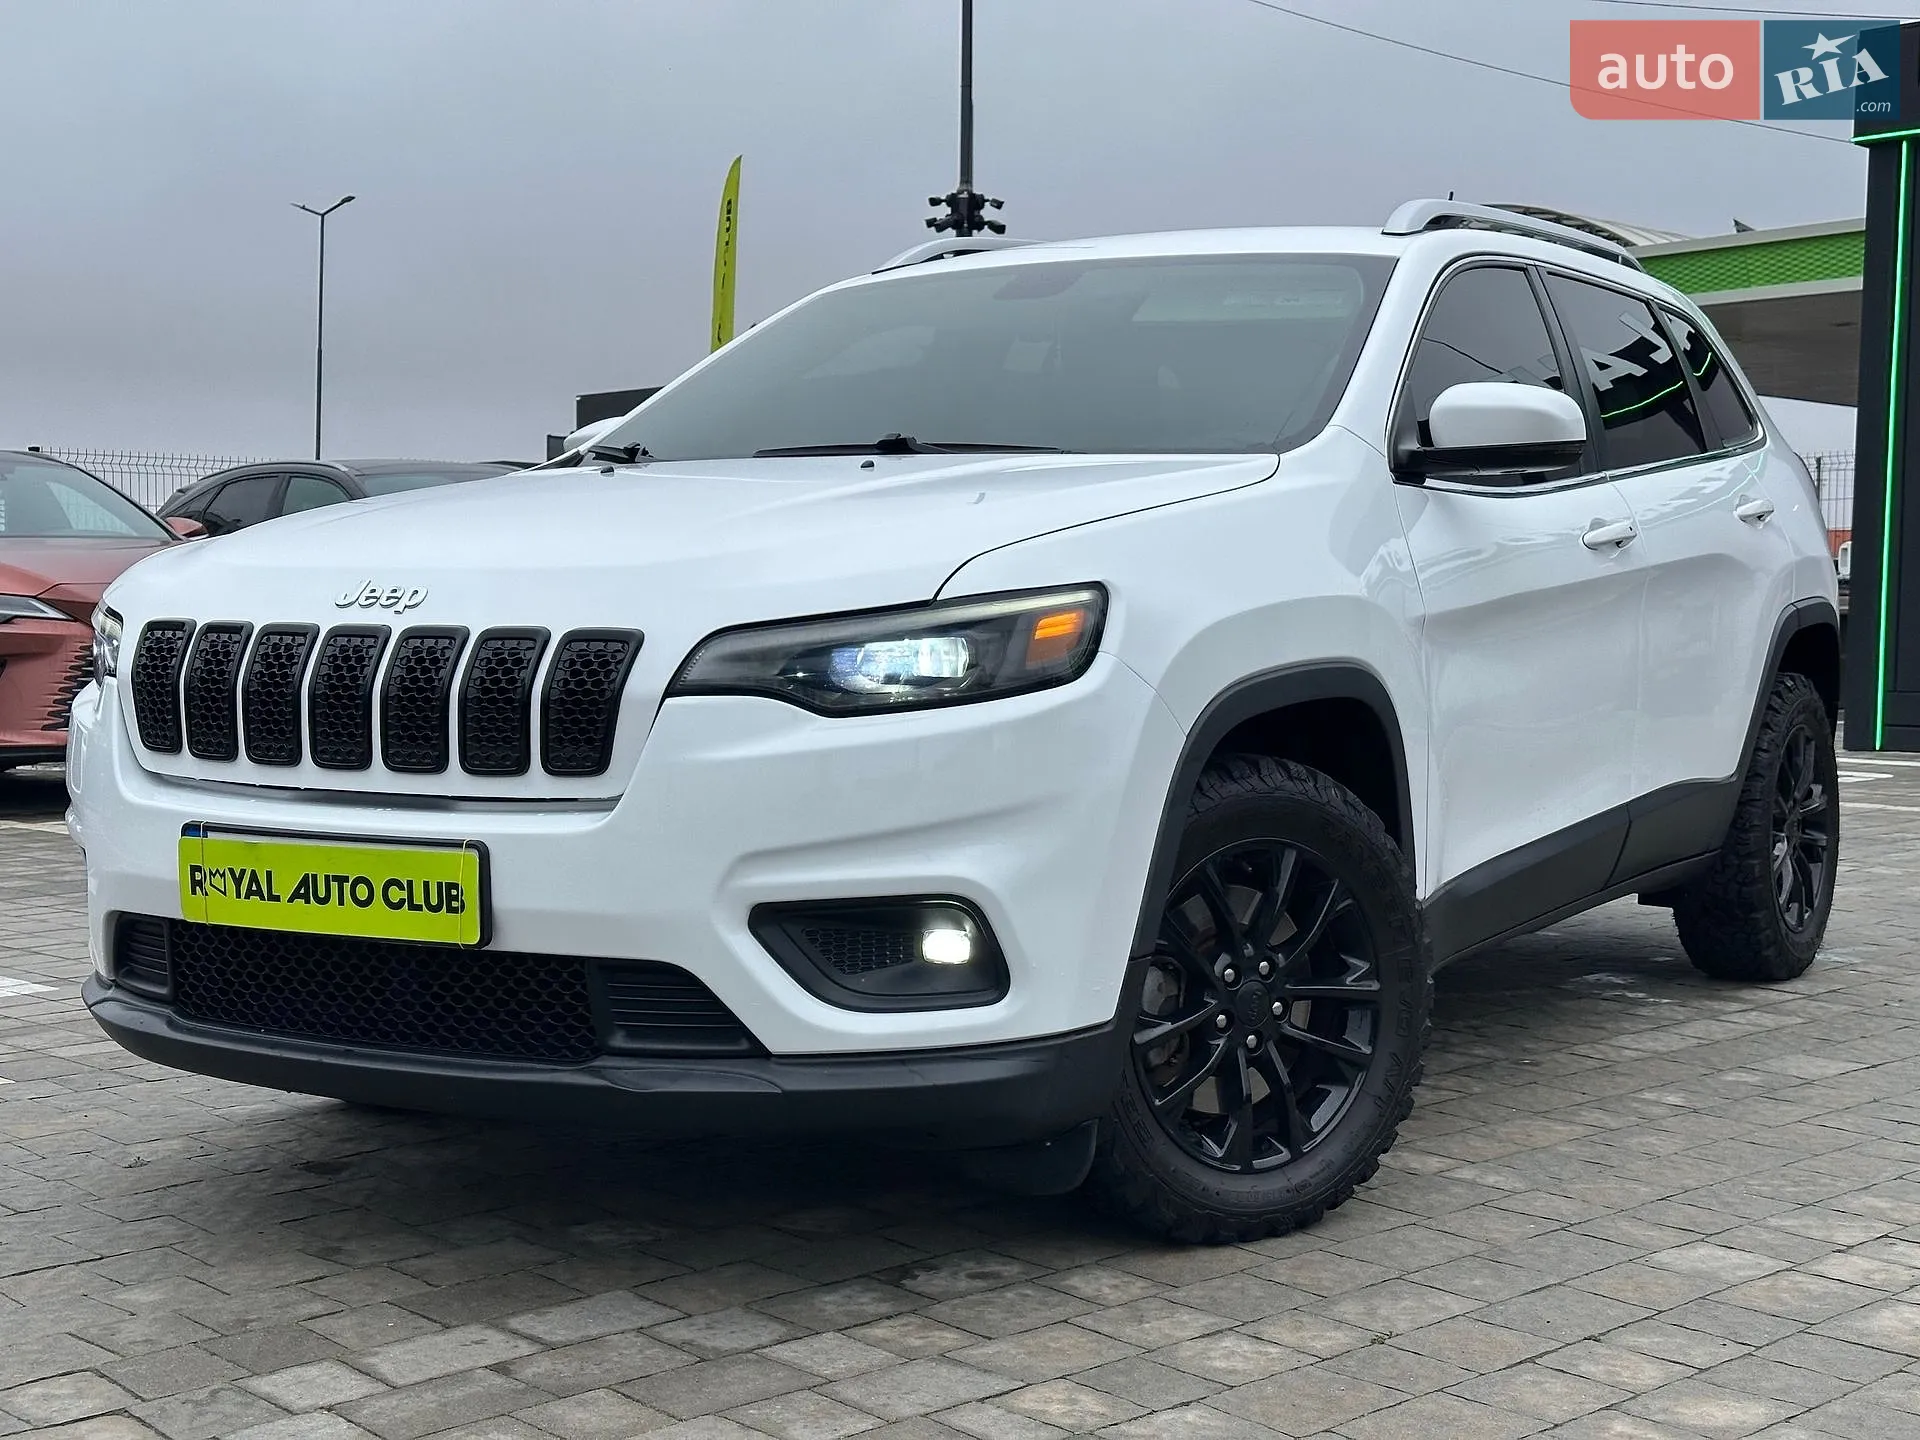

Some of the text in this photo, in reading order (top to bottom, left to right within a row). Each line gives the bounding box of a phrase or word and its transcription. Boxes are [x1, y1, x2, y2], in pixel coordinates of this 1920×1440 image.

[334, 579, 428, 614] Jeep
[287, 873, 375, 909] AUTO
[382, 878, 466, 915] CLUB
